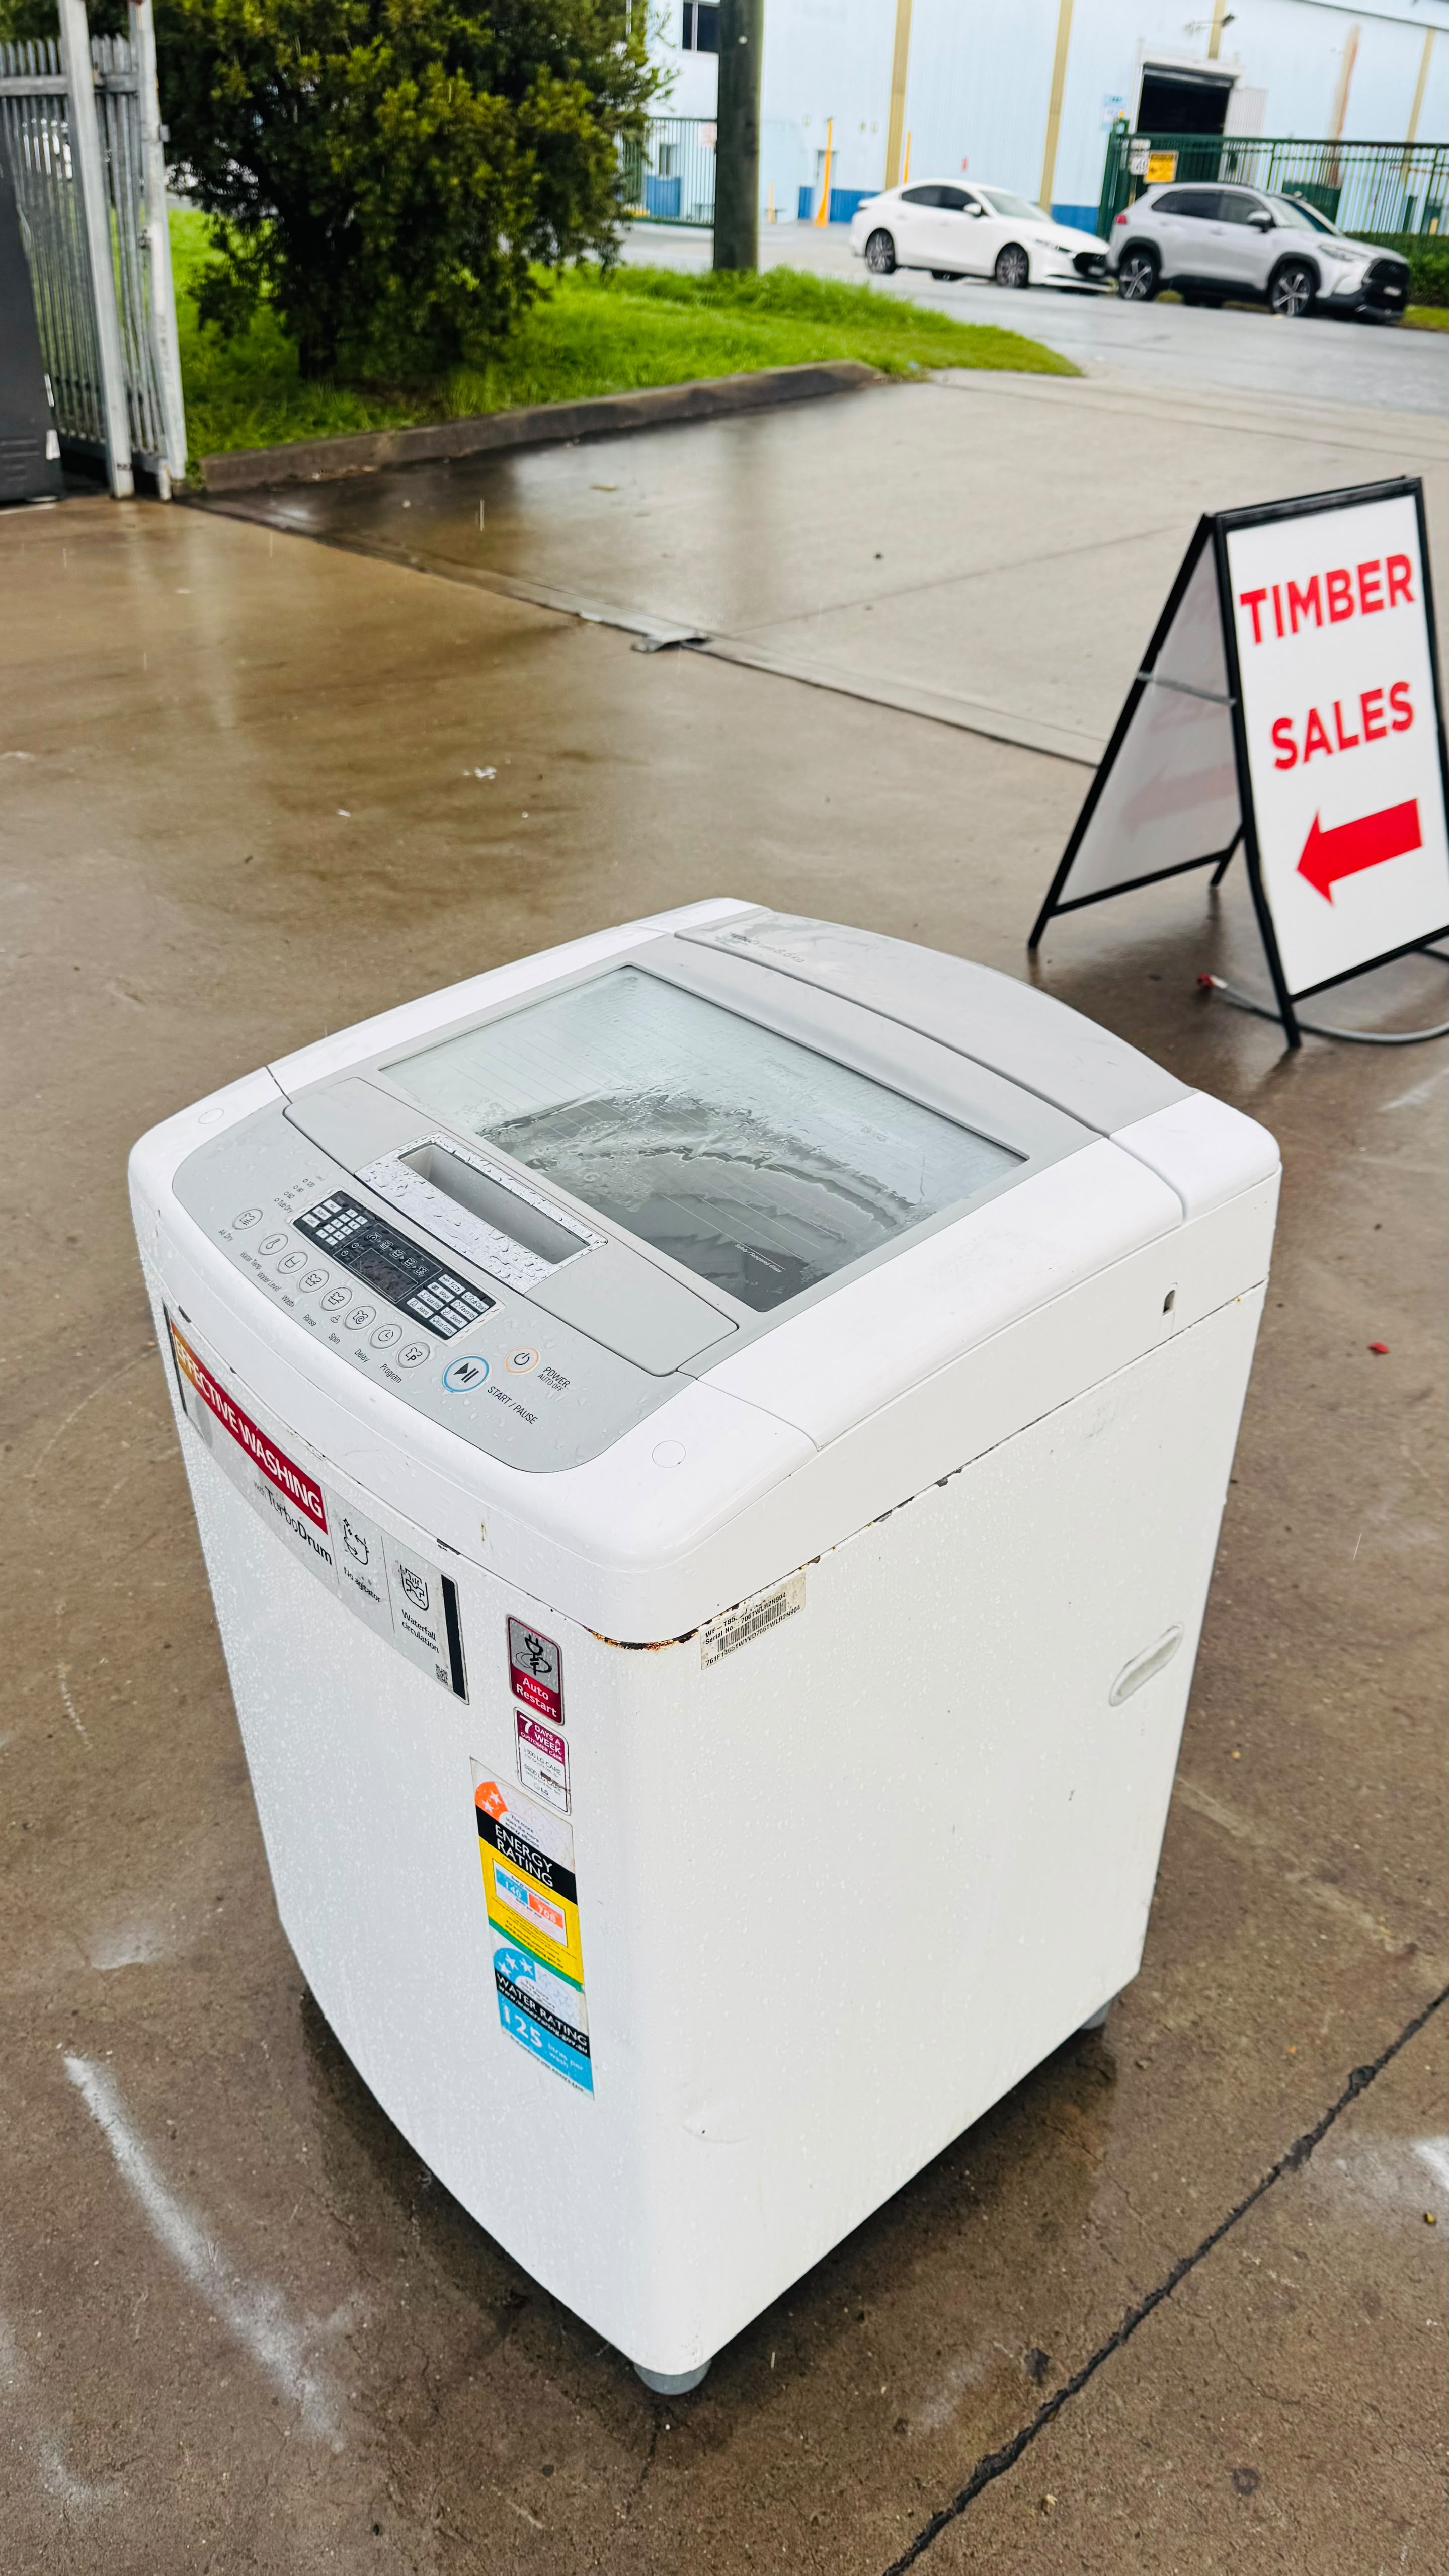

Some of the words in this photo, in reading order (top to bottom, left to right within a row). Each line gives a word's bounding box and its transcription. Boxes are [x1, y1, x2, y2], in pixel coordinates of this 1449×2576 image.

[1240, 554, 1413, 643] TIMBER
[1271, 682, 1413, 770] SALES
[281, 1294, 295, 1308] Wash
[303, 1314, 316, 1327] Rinse
[328, 1333, 341, 1344] Spin
[354, 1349, 370, 1363] Delay
[379, 1363, 402, 1383] Program
[537, 1374, 554, 1385] AUTO
[551, 1383, 564, 1392] OFF
[543, 1366, 571, 1388] POWER
[487, 1386, 512, 1404] START
[512, 1405, 538, 1424] PAUSE
[174, 1334, 239, 1433] EFFECTIVE
[238, 1418, 323, 1519] WASHING
[265, 1485, 332, 1566] TurboDrum
[344, 1567, 354, 1580] No
[355, 1578, 381, 1603] agitator
[401, 1609, 436, 1641] Waterfall
[402, 1622, 439, 1654] circulation
[705, 1631, 722, 1645] Serial
[725, 1626, 735, 1634] No.
[516, 1684, 557, 1717] Restart
[523, 1677, 549, 1701] Auto
[520, 1714, 533, 1734] 7
[534, 1725, 553, 1741] DAYS
[520, 1732, 548, 1753] CUSTOMER
[534, 1732, 561, 1755] WEEK
[541, 1787, 549, 1795] LG
[495, 1824, 552, 1873] ENERGY
[497, 1838, 553, 1887] RATING
[497, 1973, 537, 2013] WATER
[540, 2008, 587, 2047] RATING
[504, 2005, 542, 2047] 125
